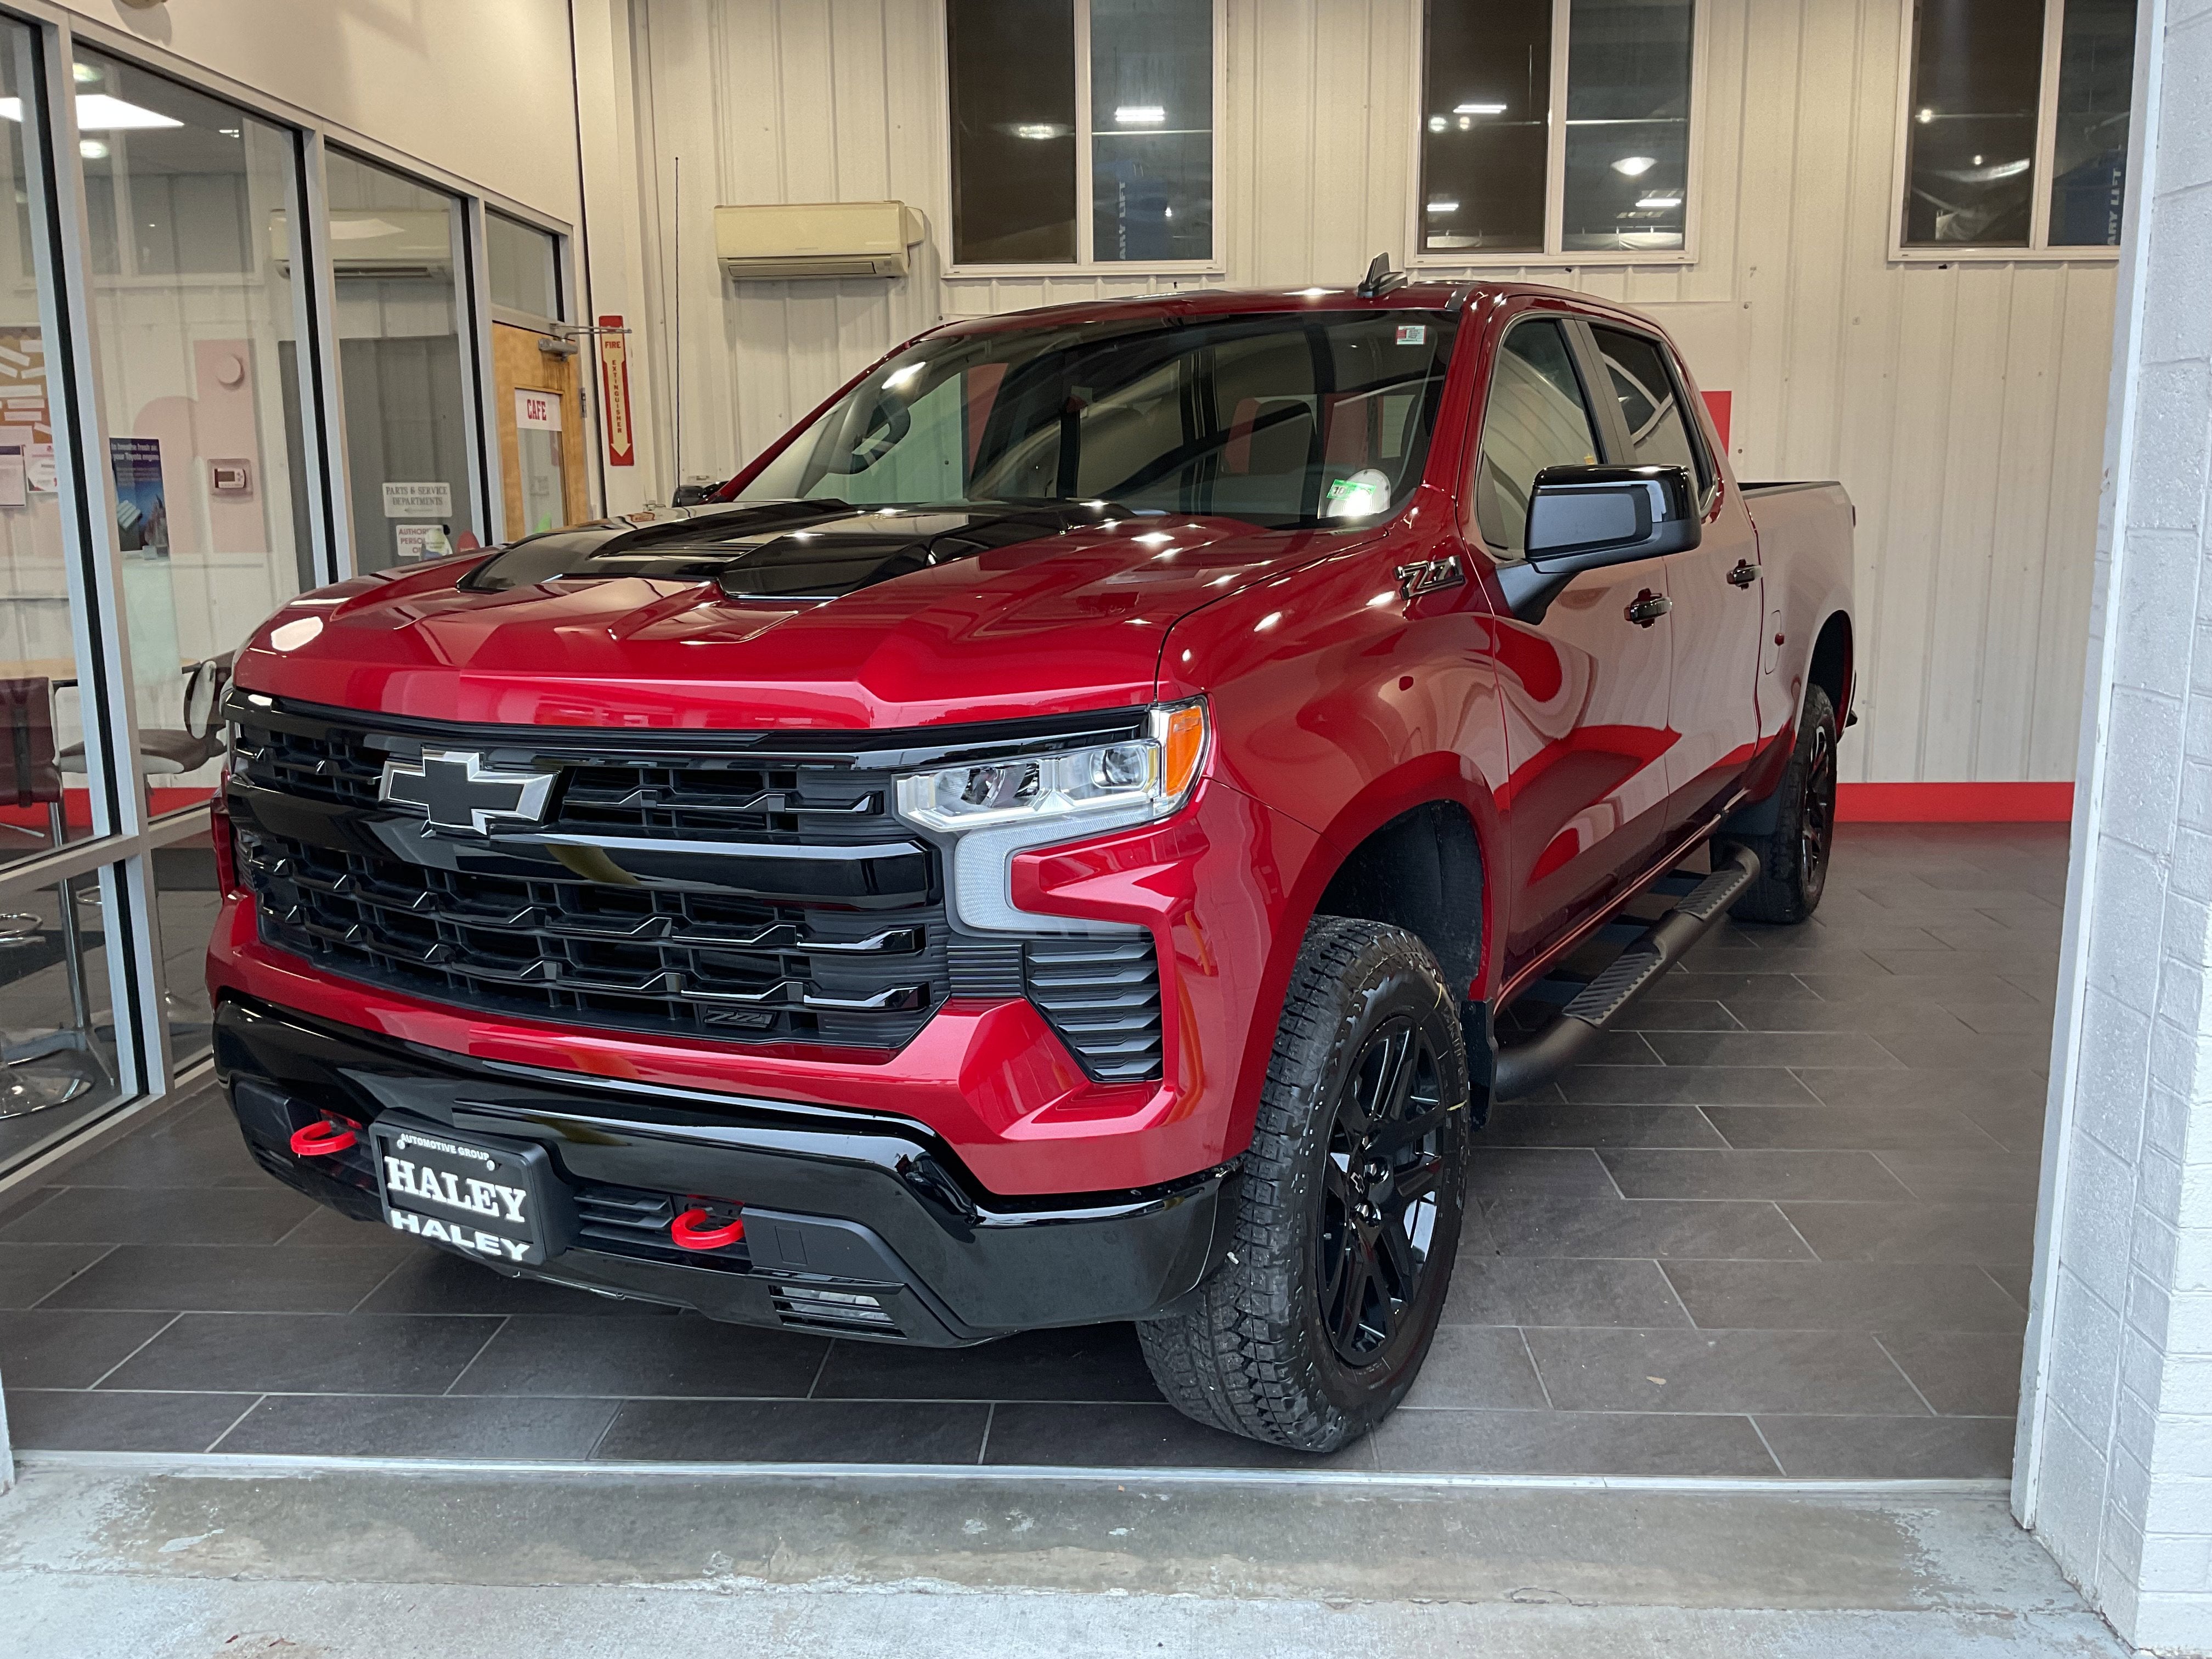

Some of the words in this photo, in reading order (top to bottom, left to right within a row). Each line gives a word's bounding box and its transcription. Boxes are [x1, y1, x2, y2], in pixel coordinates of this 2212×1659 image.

[527, 399, 546, 421] CAFE
[612, 360, 622, 433] EXTINGUISHER
[386, 487, 408, 495] PARTS
[418, 487, 448, 495] SERVICE
[393, 497, 443, 505] DEPARTMENTS
[400, 1133, 457, 1154] AUTOMOTIVE
[458, 1147, 489, 1161] GROUP
[384, 1155, 527, 1222] HALEY
[391, 1210, 530, 1261] HALEY
